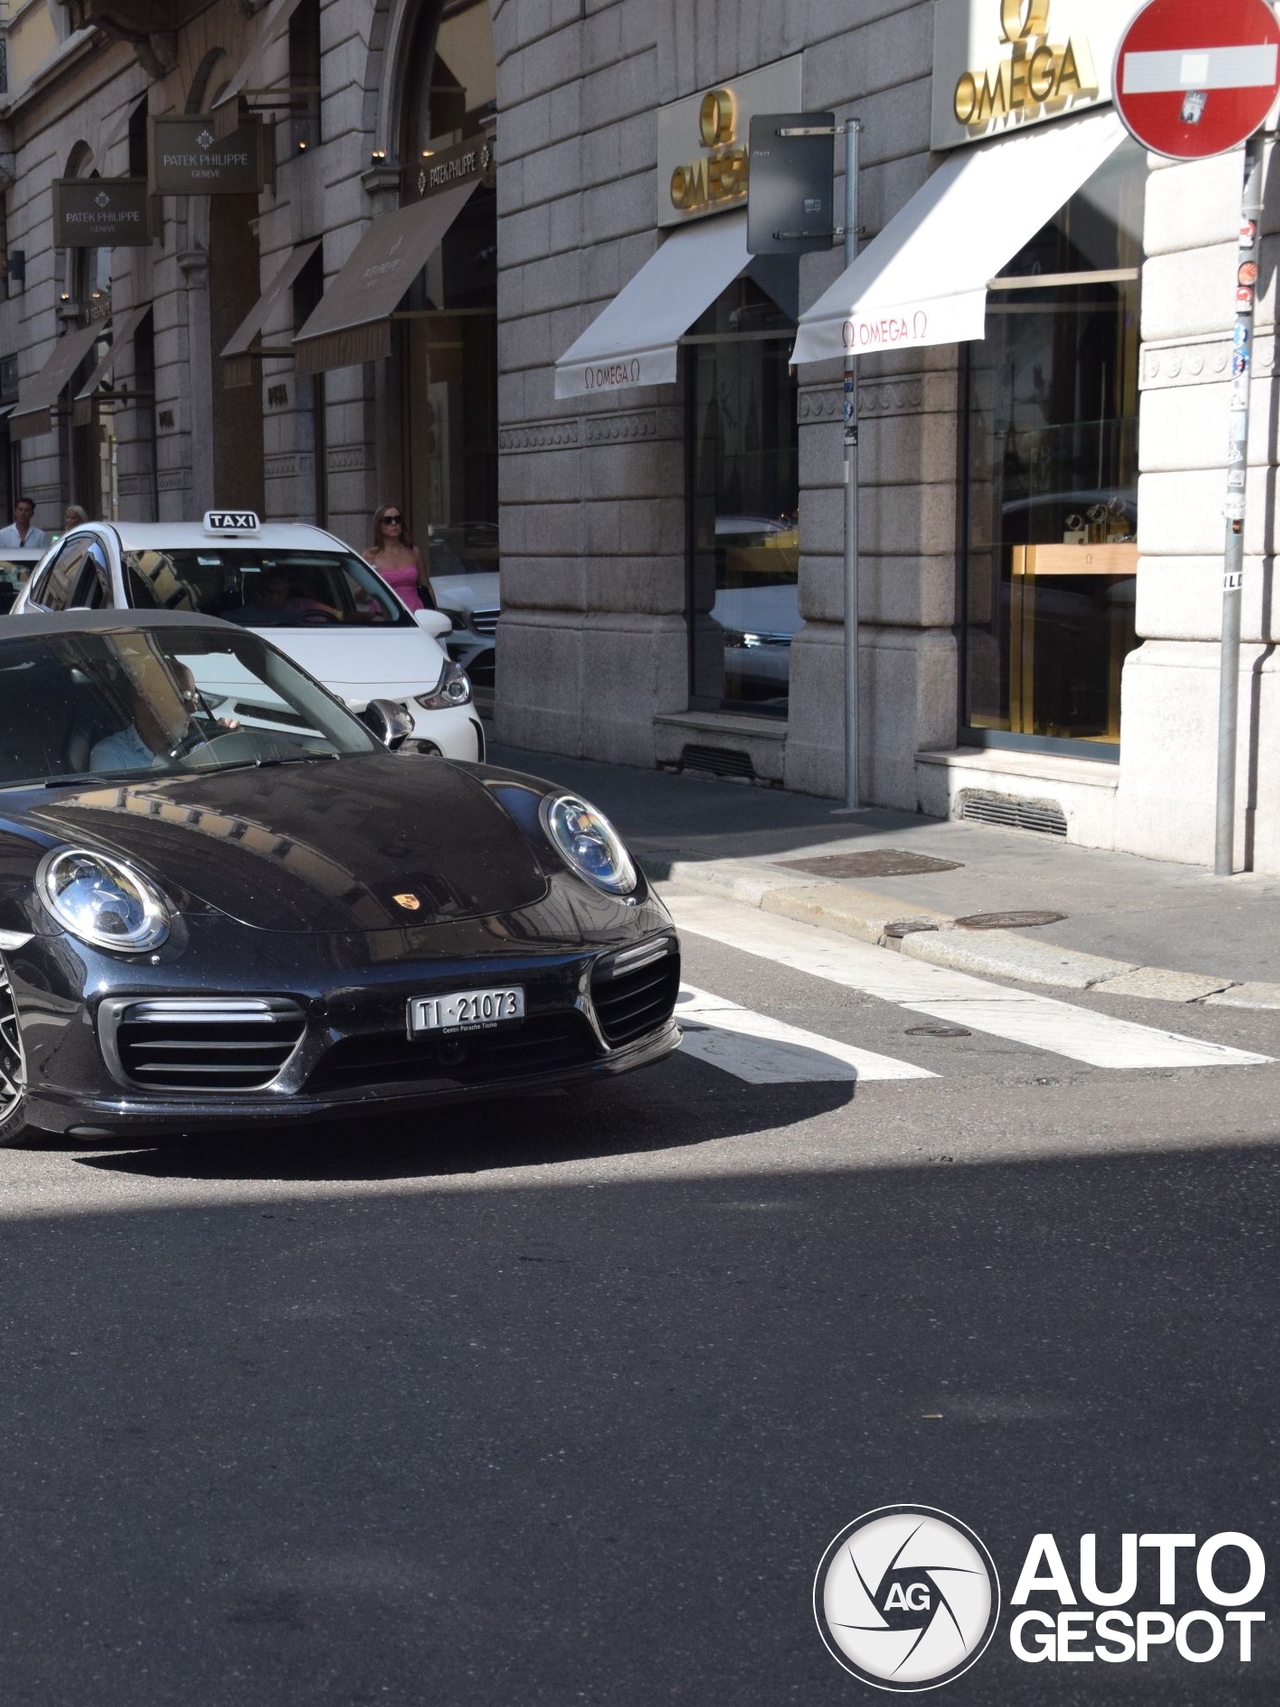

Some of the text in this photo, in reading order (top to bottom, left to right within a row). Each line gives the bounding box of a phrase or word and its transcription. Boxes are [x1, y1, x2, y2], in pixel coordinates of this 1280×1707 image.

[953, 34, 1088, 126] OMEGA
[163, 153, 248, 167] PATEK PHILIPPE
[191, 170, 220, 178] GENEVE
[429, 152, 476, 188] PATEK PHILIPPE
[66, 211, 139, 223] PATEK PHILIPPE
[859, 318, 908, 344] OMEGA
[596, 368, 628, 388] OMEGA
[210, 514, 255, 527] TAXI
[456, 990, 518, 1022] 21073
[442, 1026, 459, 1034] Centri
[460, 1023, 481, 1031] Porsche
